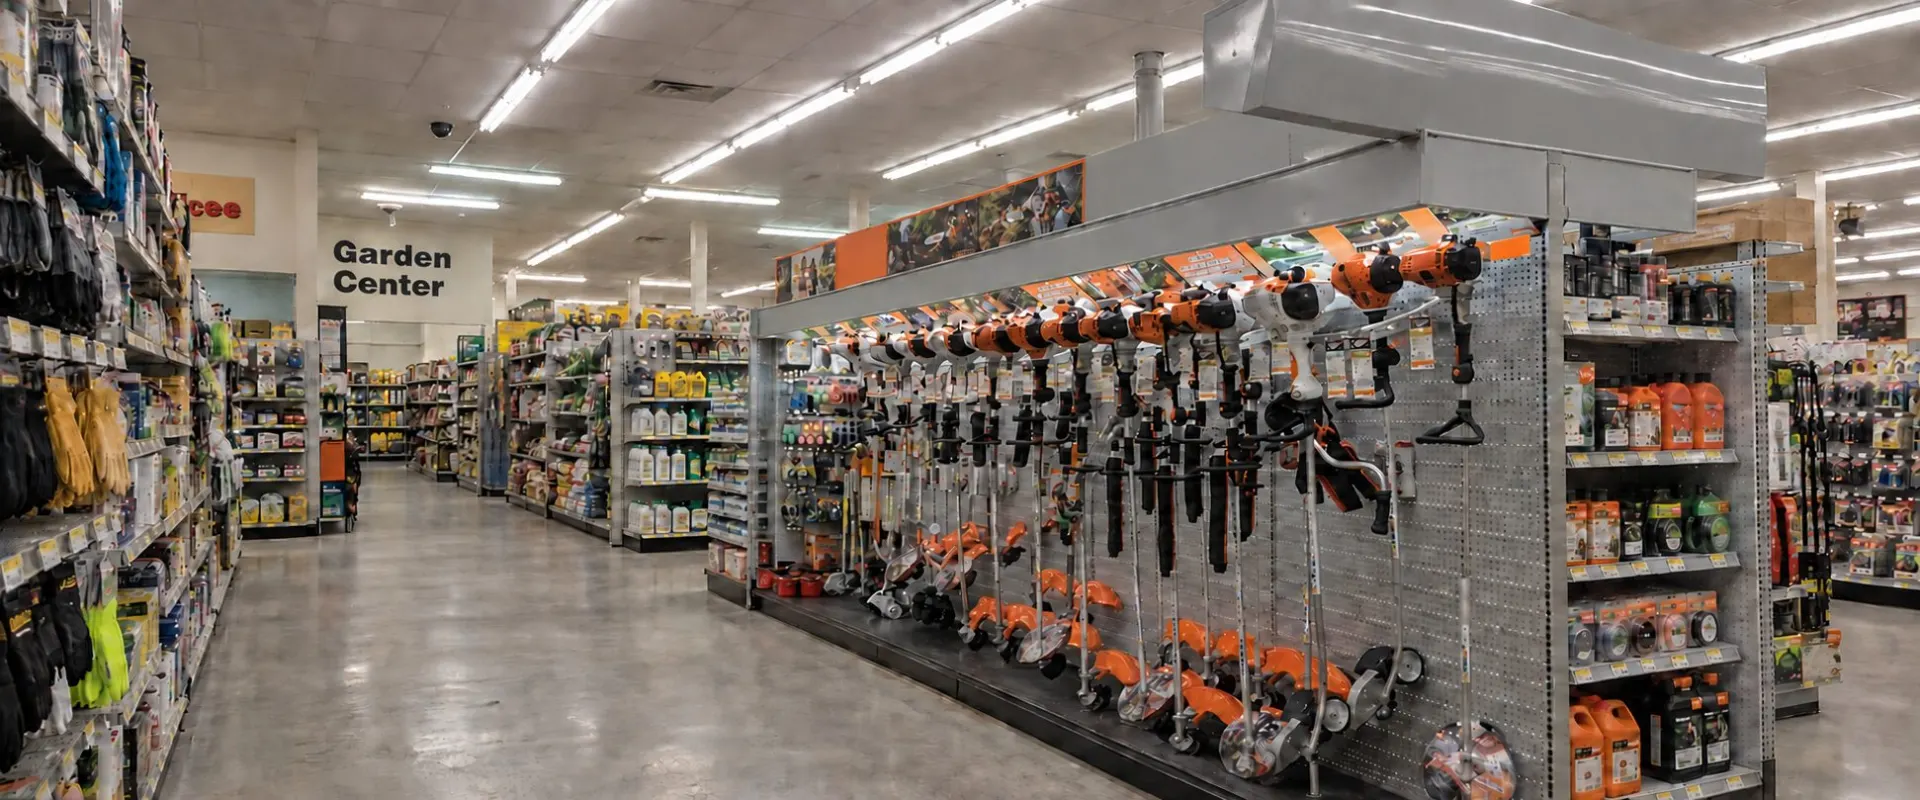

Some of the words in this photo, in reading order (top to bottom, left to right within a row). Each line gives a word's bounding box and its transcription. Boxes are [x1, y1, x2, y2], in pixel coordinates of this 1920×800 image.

[182, 194, 241, 219] cee
[333, 240, 451, 269] Garden
[333, 270, 445, 297] Center
